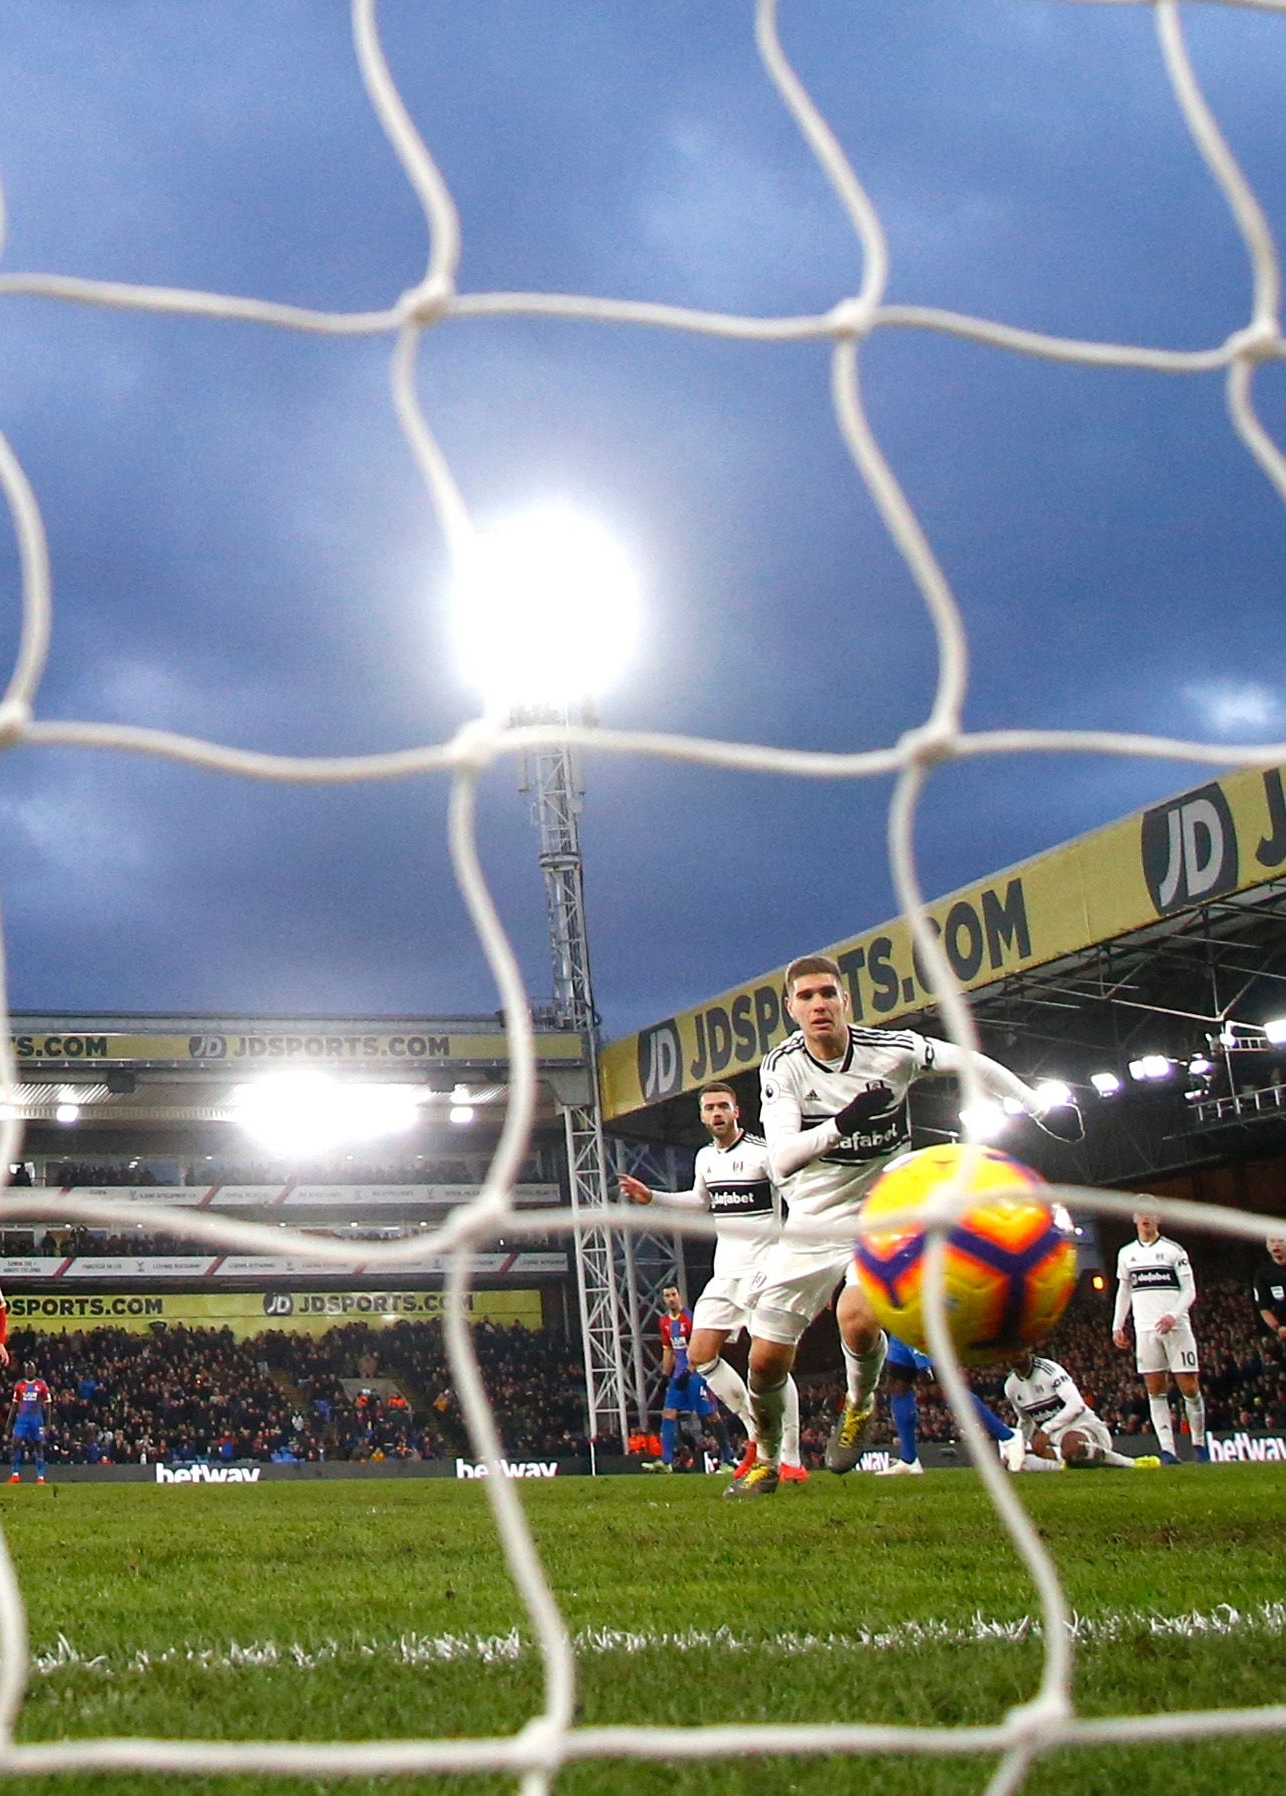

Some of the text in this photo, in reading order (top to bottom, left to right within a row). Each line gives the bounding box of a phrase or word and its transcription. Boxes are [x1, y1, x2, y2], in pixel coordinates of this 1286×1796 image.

[1158, 798, 1224, 908] JD
[233, 1036, 450, 1057] JDSPORTS.COM
[645, 1028, 678, 1097] JD
[835, 1123, 898, 1150] afabet
[267, 1293, 291, 1313] JD
[1181, 1351, 1196, 1367] 10
[156, 1462, 261, 1483] betway
[456, 1458, 558, 1479] beway
